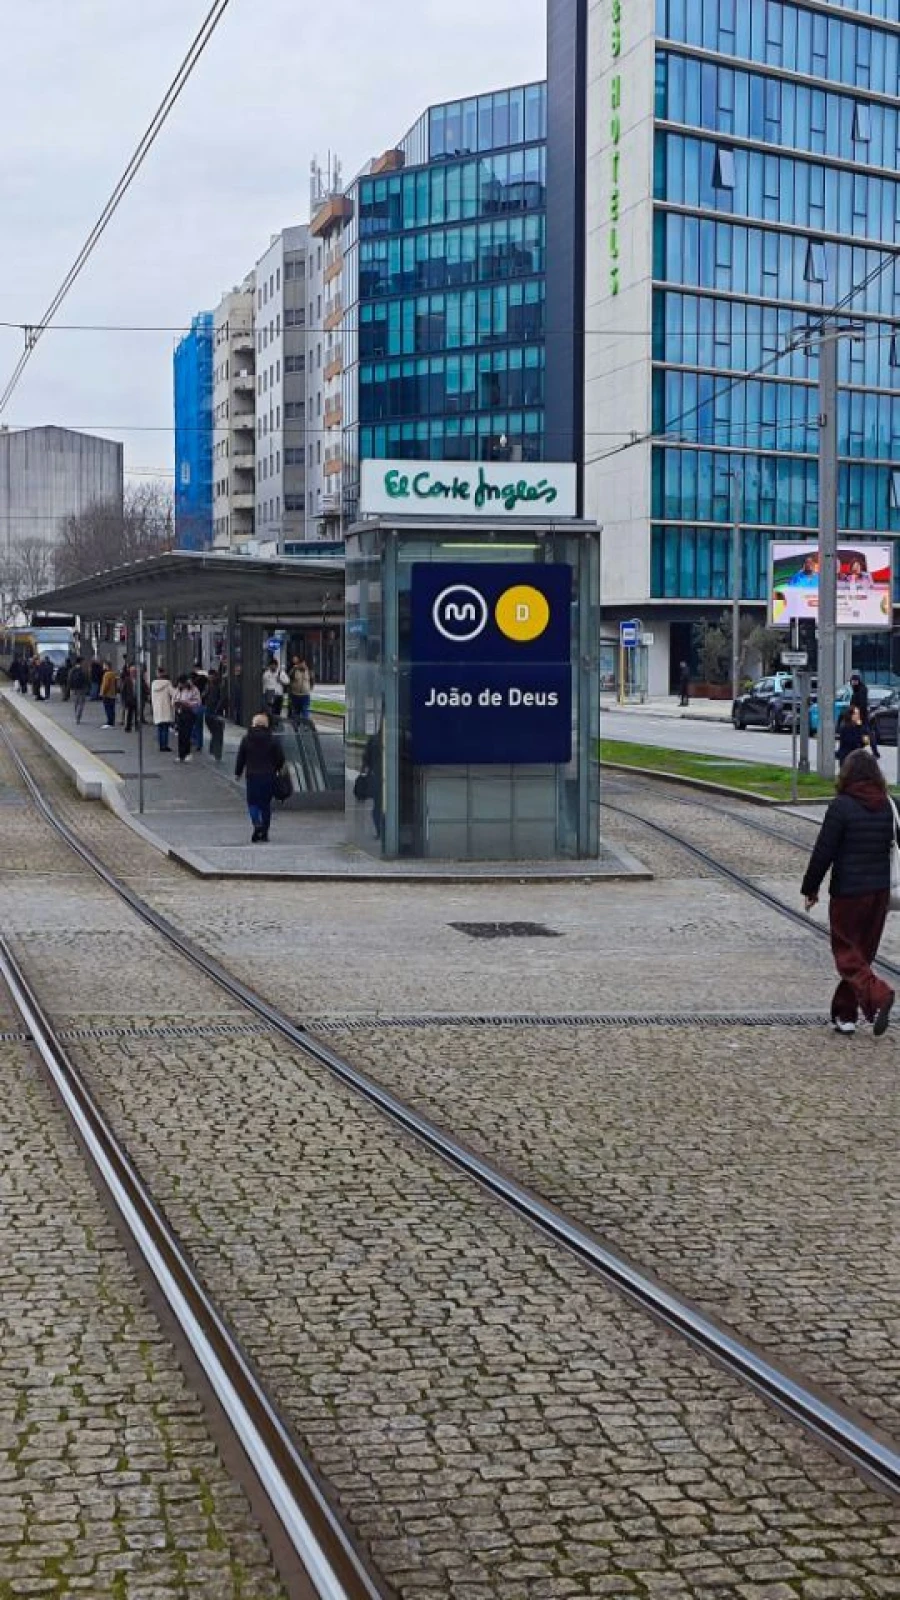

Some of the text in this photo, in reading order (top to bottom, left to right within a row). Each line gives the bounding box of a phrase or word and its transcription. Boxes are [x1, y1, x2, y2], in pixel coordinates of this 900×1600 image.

[384, 467, 558, 510] El Corte Inglés
[516, 604, 530, 622] D
[424, 687, 559, 706] João de Deus
